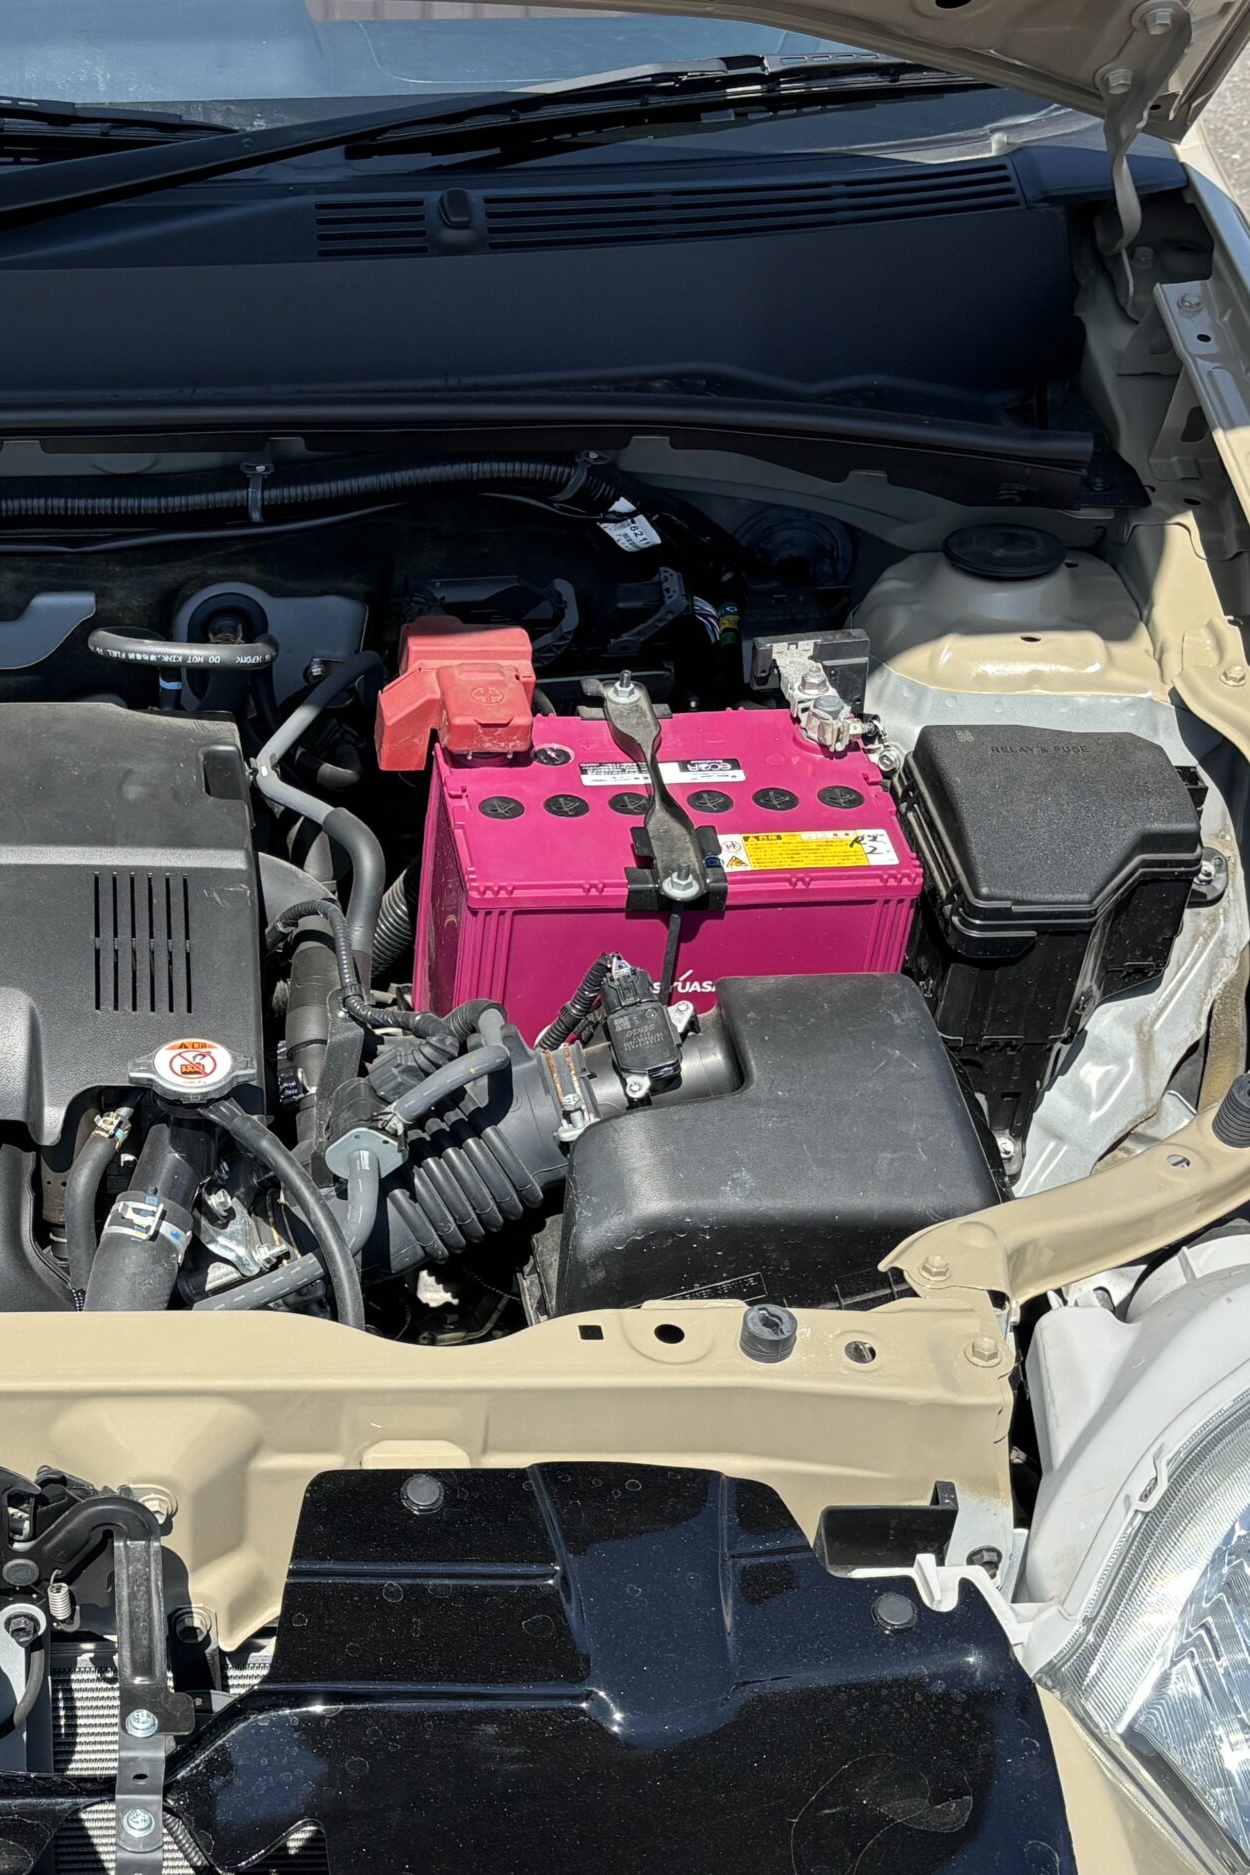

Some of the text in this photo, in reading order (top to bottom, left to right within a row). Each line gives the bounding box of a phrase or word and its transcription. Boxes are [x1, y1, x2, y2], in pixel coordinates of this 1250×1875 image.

[186, 655, 204, 664] NOT
[208, 656, 221, 664] DO
[991, 745, 1034, 754] RELAY
